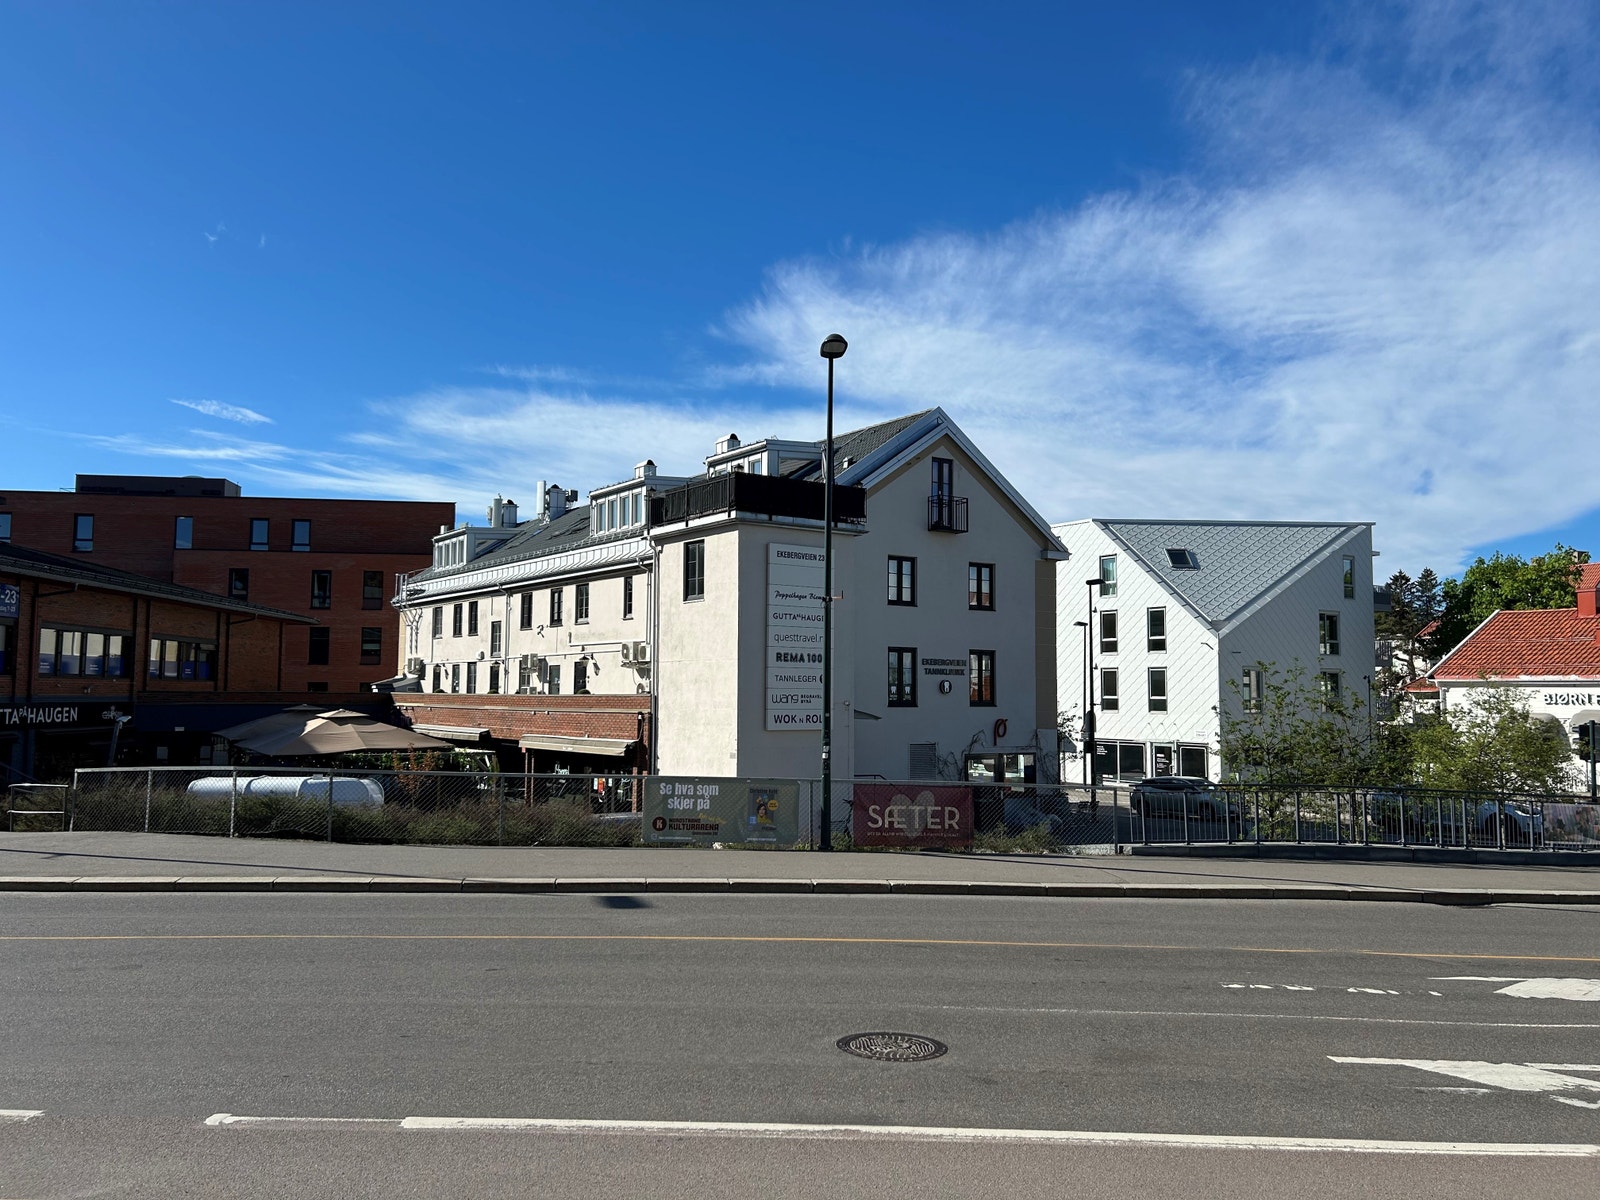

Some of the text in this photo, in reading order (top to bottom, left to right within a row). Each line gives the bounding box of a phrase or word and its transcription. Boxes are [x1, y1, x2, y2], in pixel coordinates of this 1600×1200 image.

[776, 550, 817, 561] EKEBERGVEIEN
[774, 634, 824, 643] questtravel.n
[776, 652, 822, 664] REMA 100
[922, 658, 967, 666] EKEBERGVEIEN
[924, 668, 965, 676] TANNKLINIKK
[774, 674, 817, 682] TANNLEGER
[772, 694, 799, 704] wang
[1544, 693, 1593, 706] BJØRN
[0, 708, 20, 724] TA
[28, 707, 78, 723] HAUGEN
[774, 714, 797, 724] WOK
[806, 714, 822, 724] ROL
[660, 782, 719, 795] Se hva som
[668, 795, 710, 810] skjer på
[867, 805, 960, 829] SÆTER
